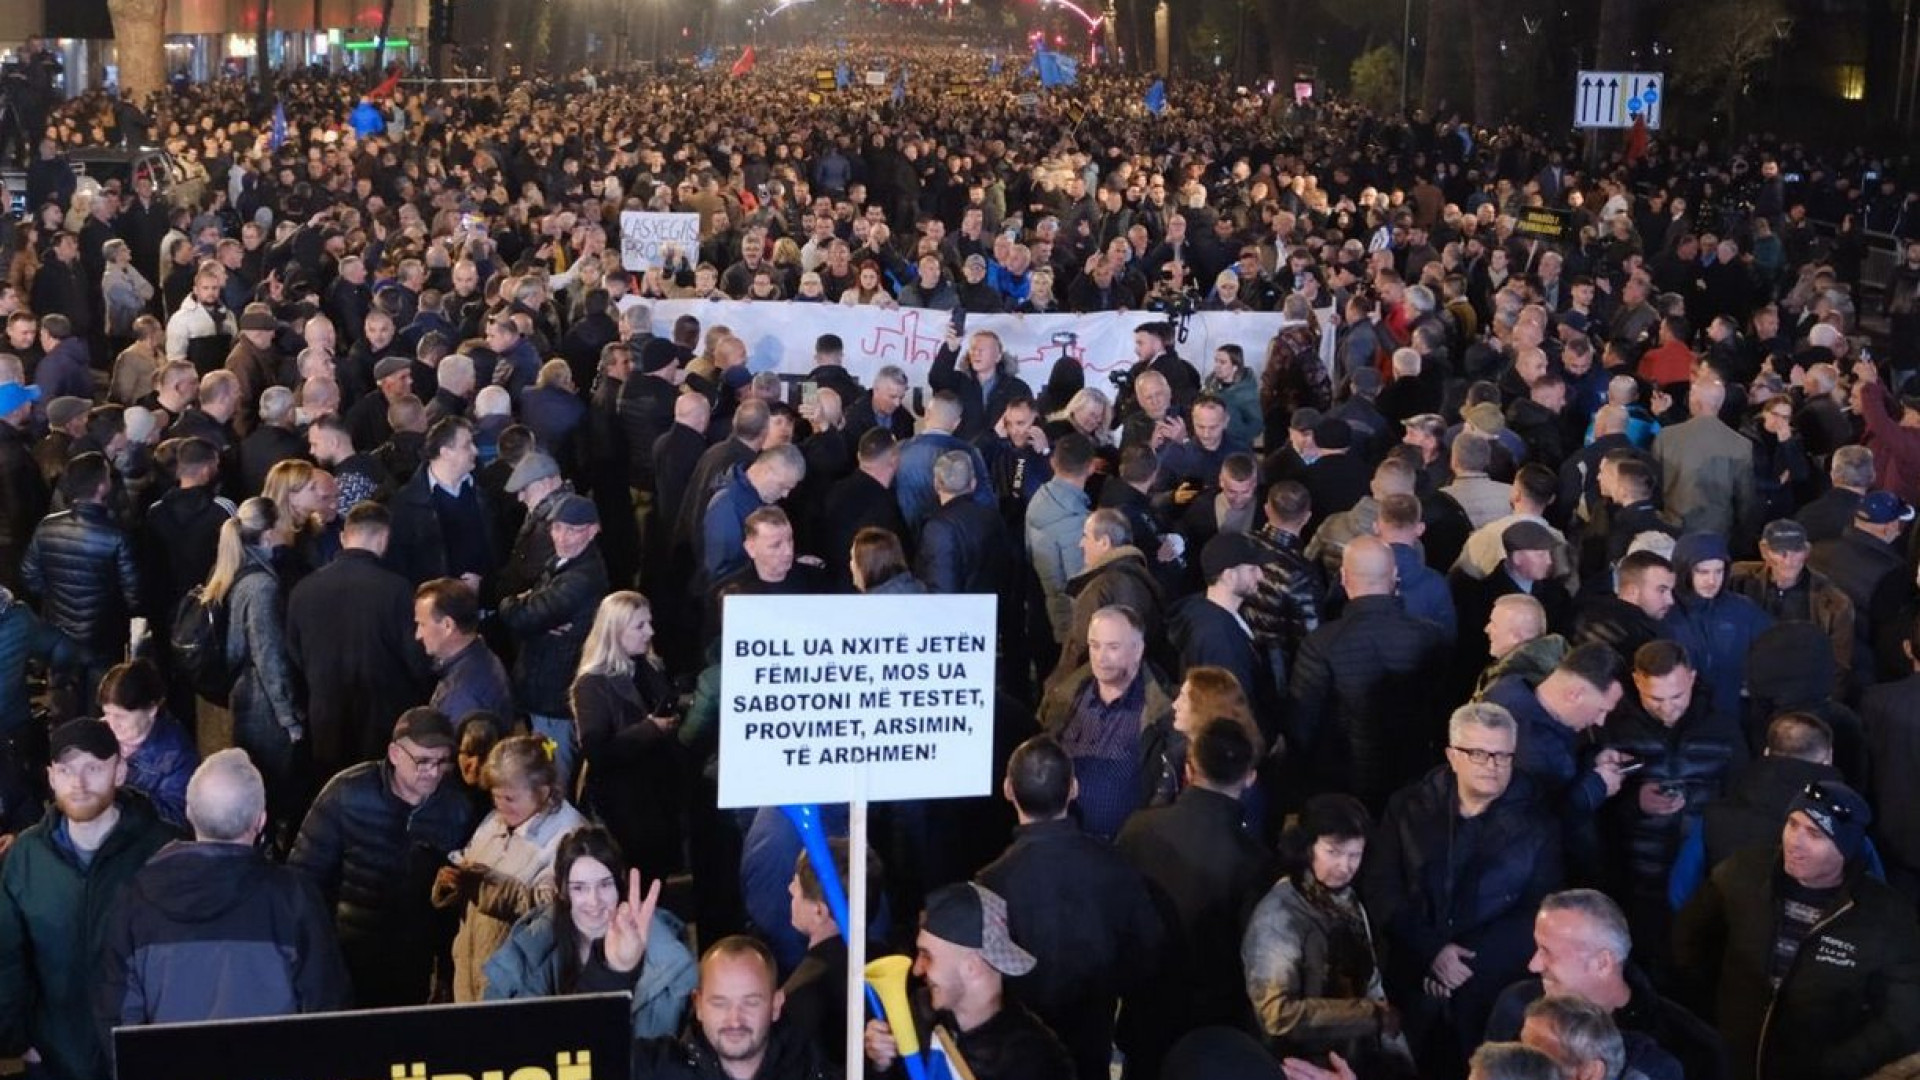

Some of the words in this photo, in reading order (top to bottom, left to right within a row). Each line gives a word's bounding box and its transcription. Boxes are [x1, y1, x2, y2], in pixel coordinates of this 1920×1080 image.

[736, 640, 794, 657] BOLL
[804, 639, 833, 656] UA
[842, 633, 908, 654] NXITË
[916, 632, 985, 653] JETËN
[756, 662, 874, 684] FËMIJËVE,
[883, 663, 929, 681] MOS
[938, 663, 966, 679] UA
[734, 693, 850, 712] SABOTONI
[860, 687, 890, 708] MË
[899, 689, 984, 707] TESTET,
[745, 720, 865, 740] PROVIMET,
[874, 716, 972, 734] ARSIMIN,
[783, 745, 810, 766] TË
[819, 744, 936, 764] ARDHMEN!
